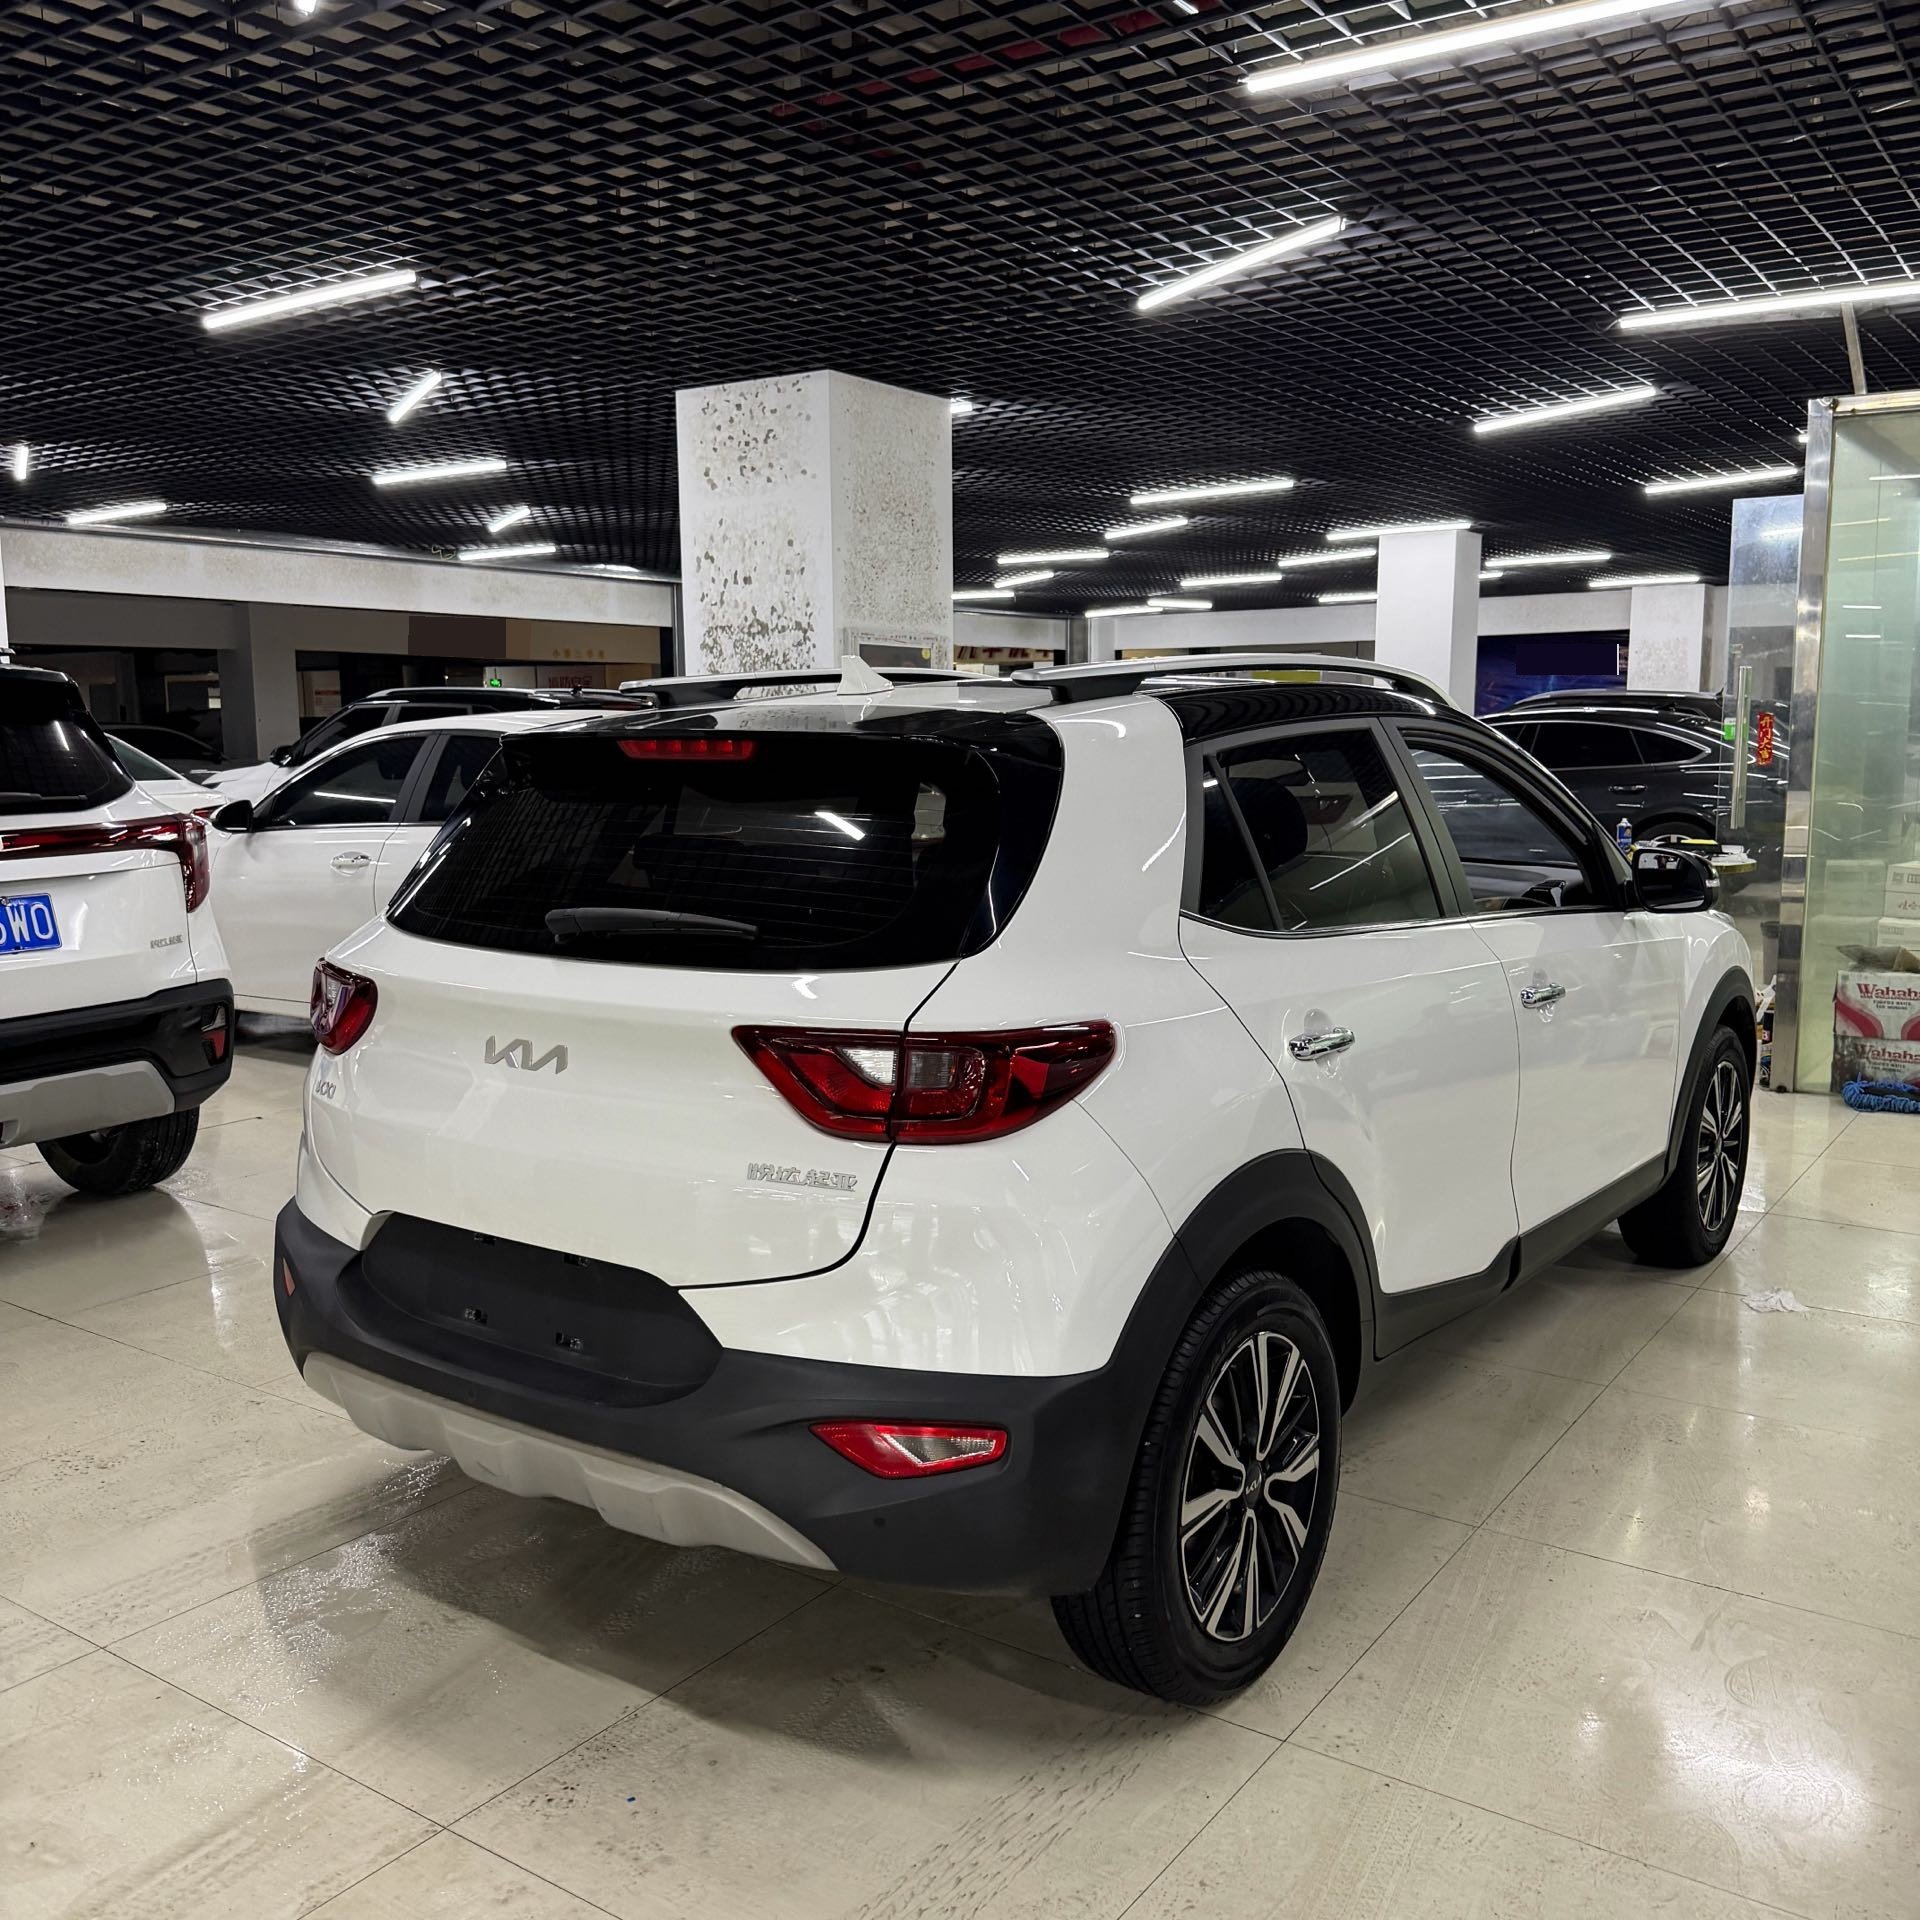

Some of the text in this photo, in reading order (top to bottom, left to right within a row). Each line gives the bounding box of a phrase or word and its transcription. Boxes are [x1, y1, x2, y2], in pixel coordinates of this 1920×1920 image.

[1759, 714, 1773, 764] 开门大吉
[1856, 983, 1920, 998] Wahah
[485, 1035, 568, 1074] KIA
